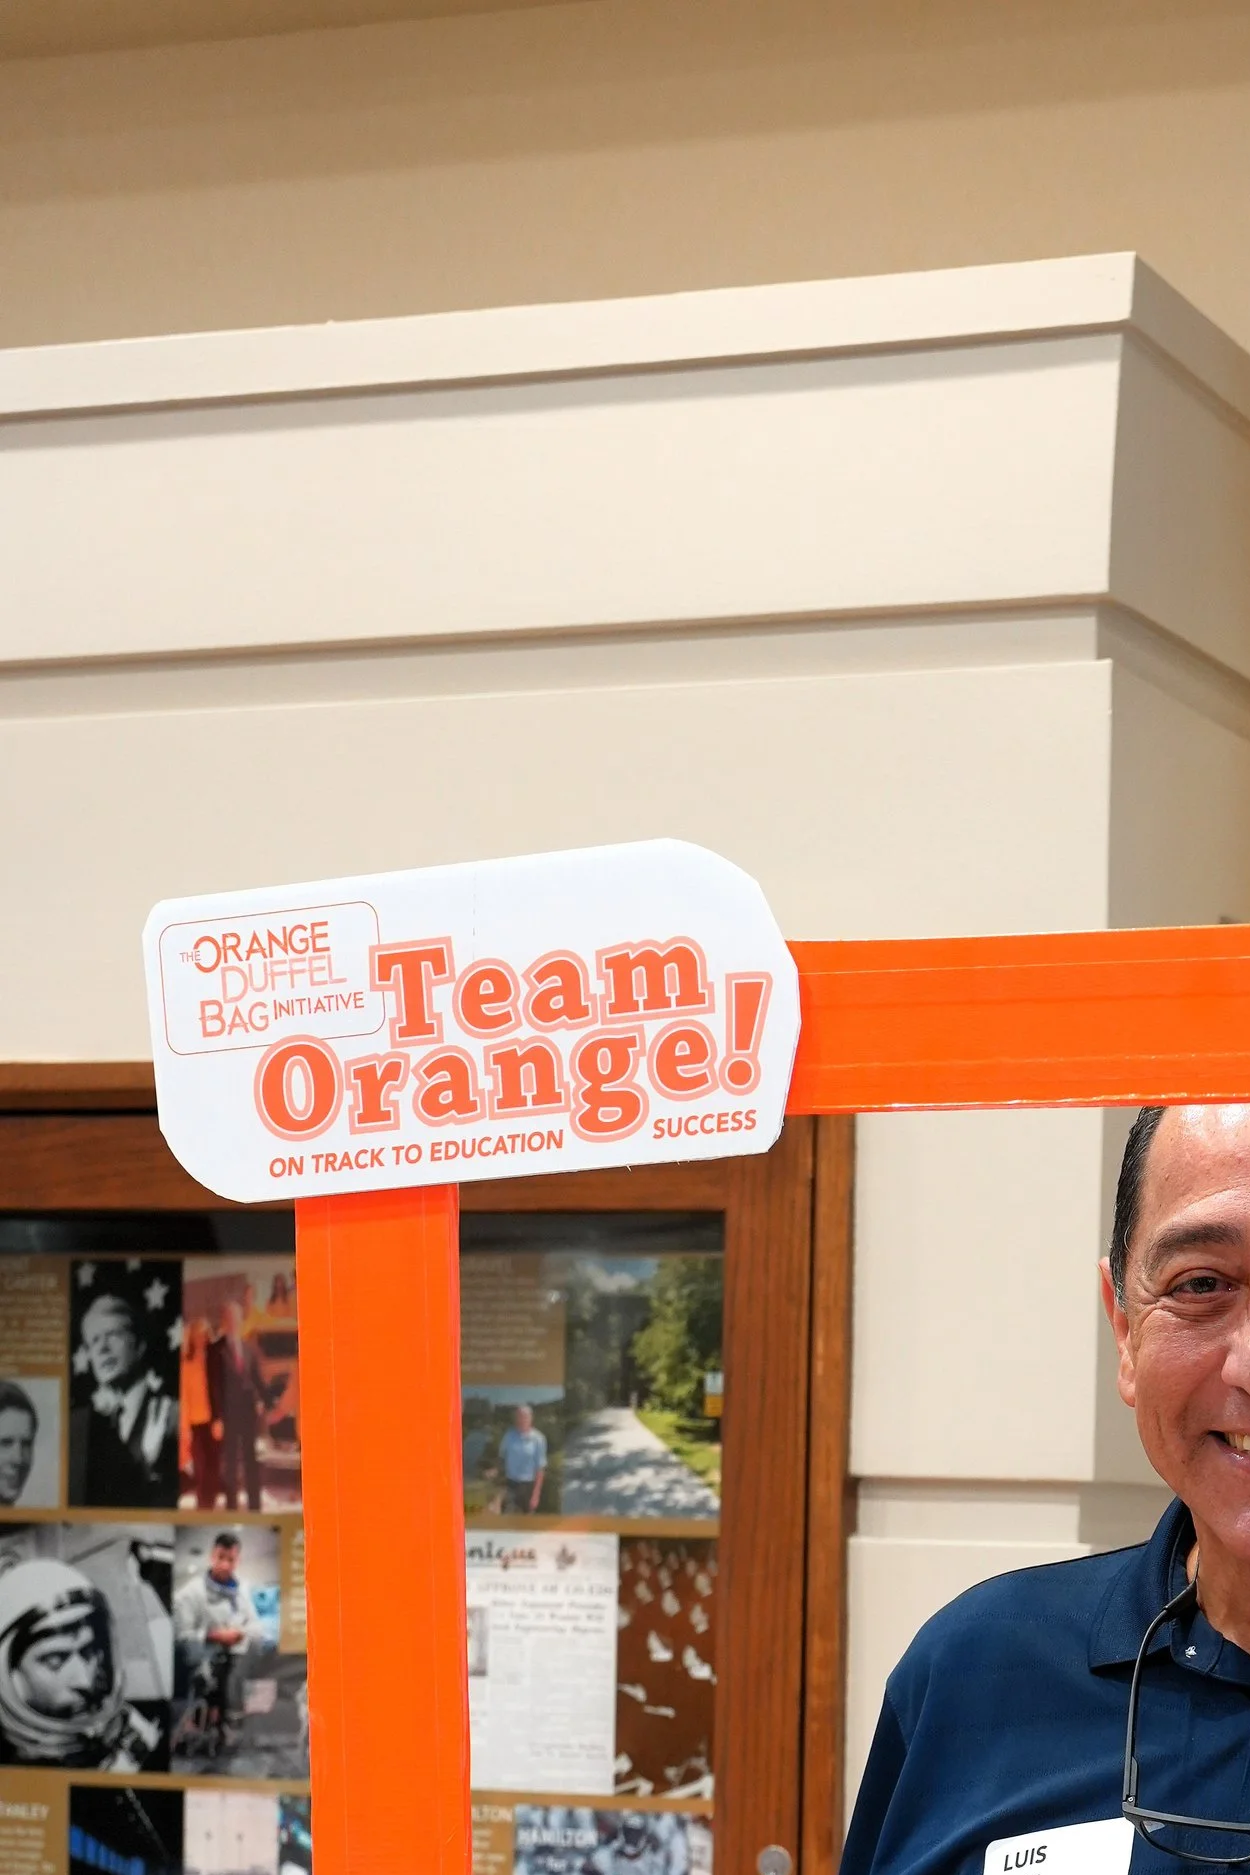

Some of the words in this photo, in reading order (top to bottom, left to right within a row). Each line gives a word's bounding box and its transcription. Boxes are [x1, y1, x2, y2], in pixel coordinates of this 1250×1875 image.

[179, 951, 201, 963] THE
[193, 921, 330, 973] ORANGE
[221, 954, 347, 1004] DUFFEL
[369, 936, 715, 1046] Team
[199, 999, 269, 1038] BAG
[274, 992, 365, 1020] INITIATIVE
[254, 972, 773, 1142] Orange!
[269, 1157, 305, 1179] ON
[311, 1149, 386, 1174] TRACK
[391, 1143, 423, 1167] TO
[429, 1129, 564, 1163] EDUCATION
[652, 1109, 758, 1140] SUCCESS
[1003, 1845, 1048, 1872] LUIS
